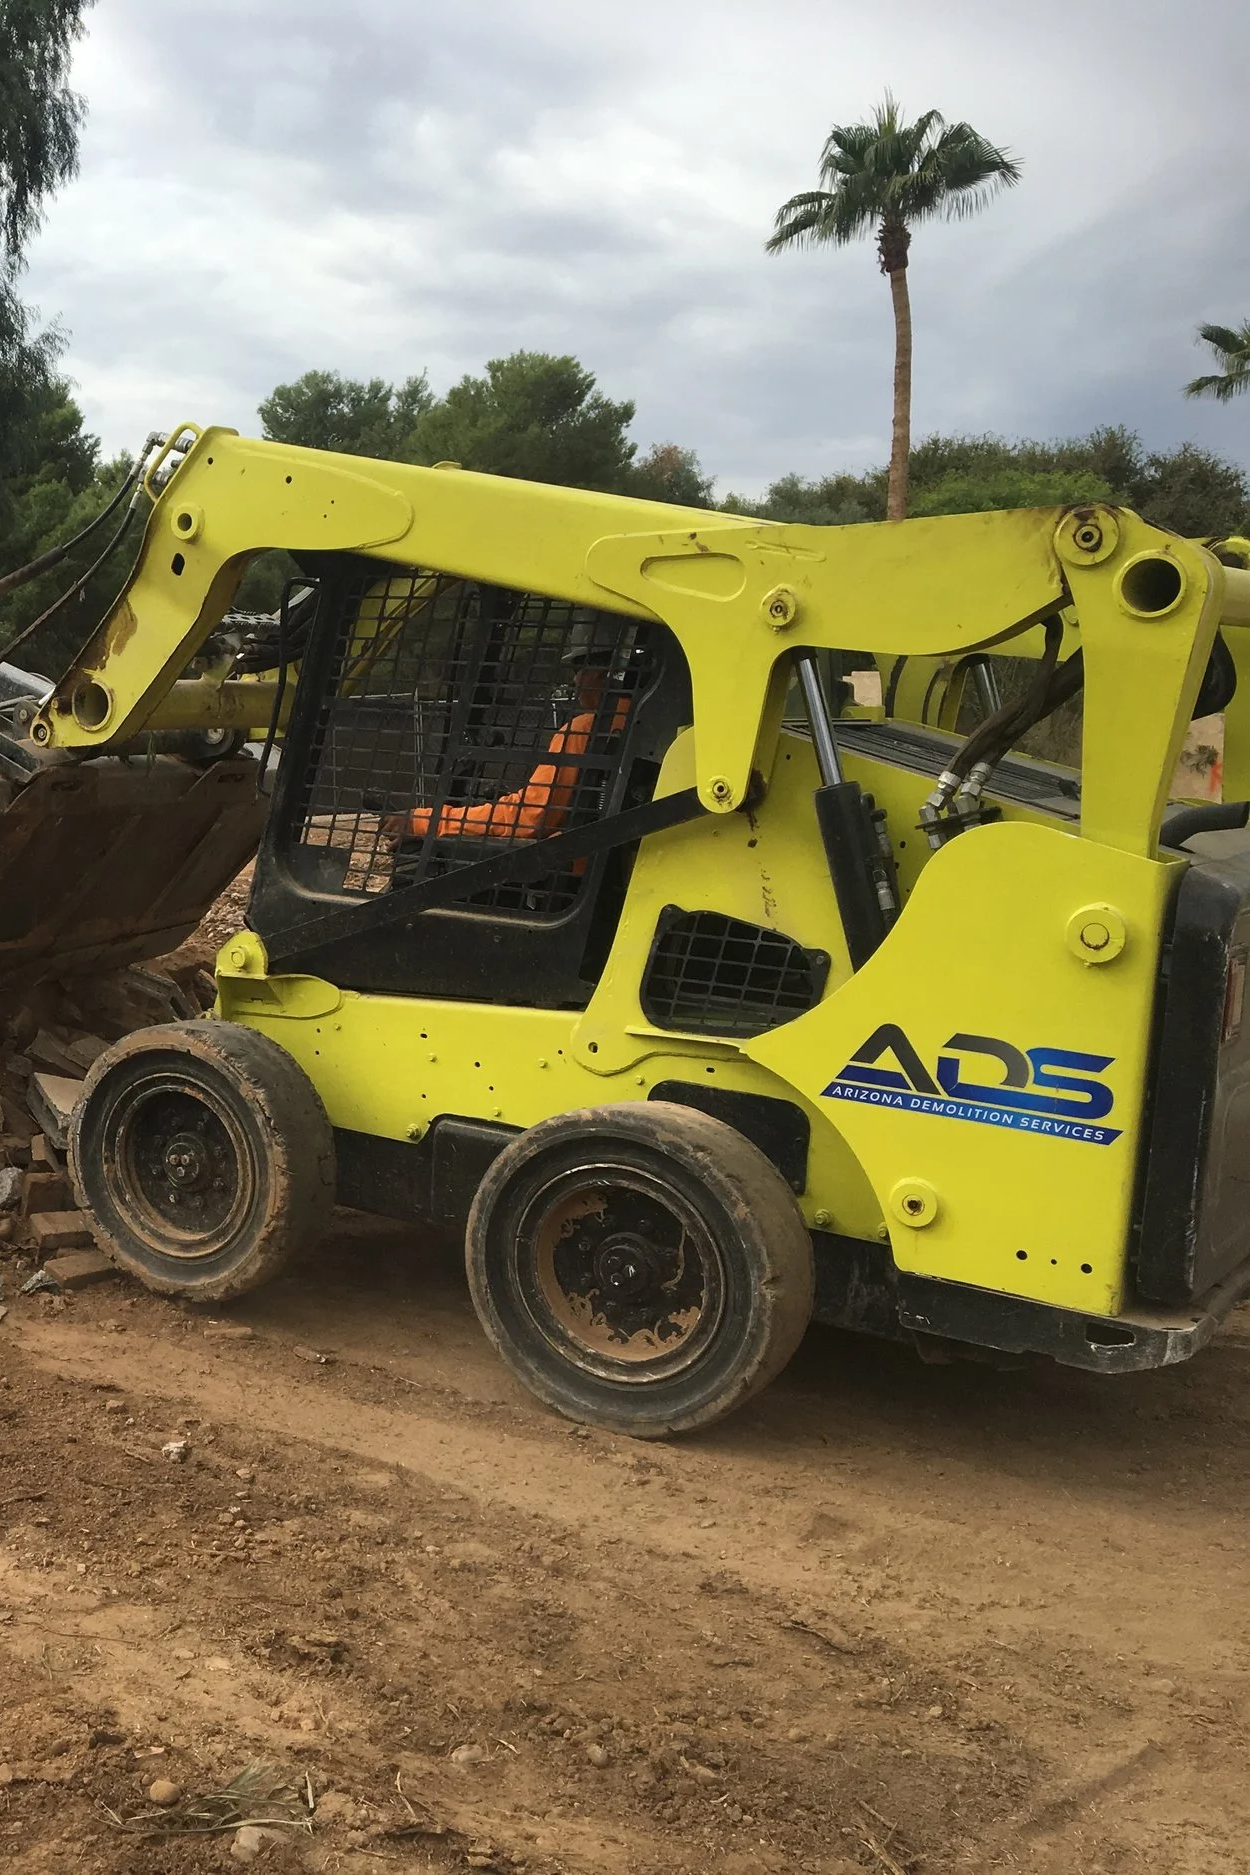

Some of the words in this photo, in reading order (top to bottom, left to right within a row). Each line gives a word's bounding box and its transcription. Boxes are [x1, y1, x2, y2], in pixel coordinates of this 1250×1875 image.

[835, 1023, 1116, 1120] ADS
[832, 1086, 903, 1106] ARIZONA
[910, 1098, 1014, 1124] DEMOLITION
[1020, 1117, 1105, 1141] SERVICES
